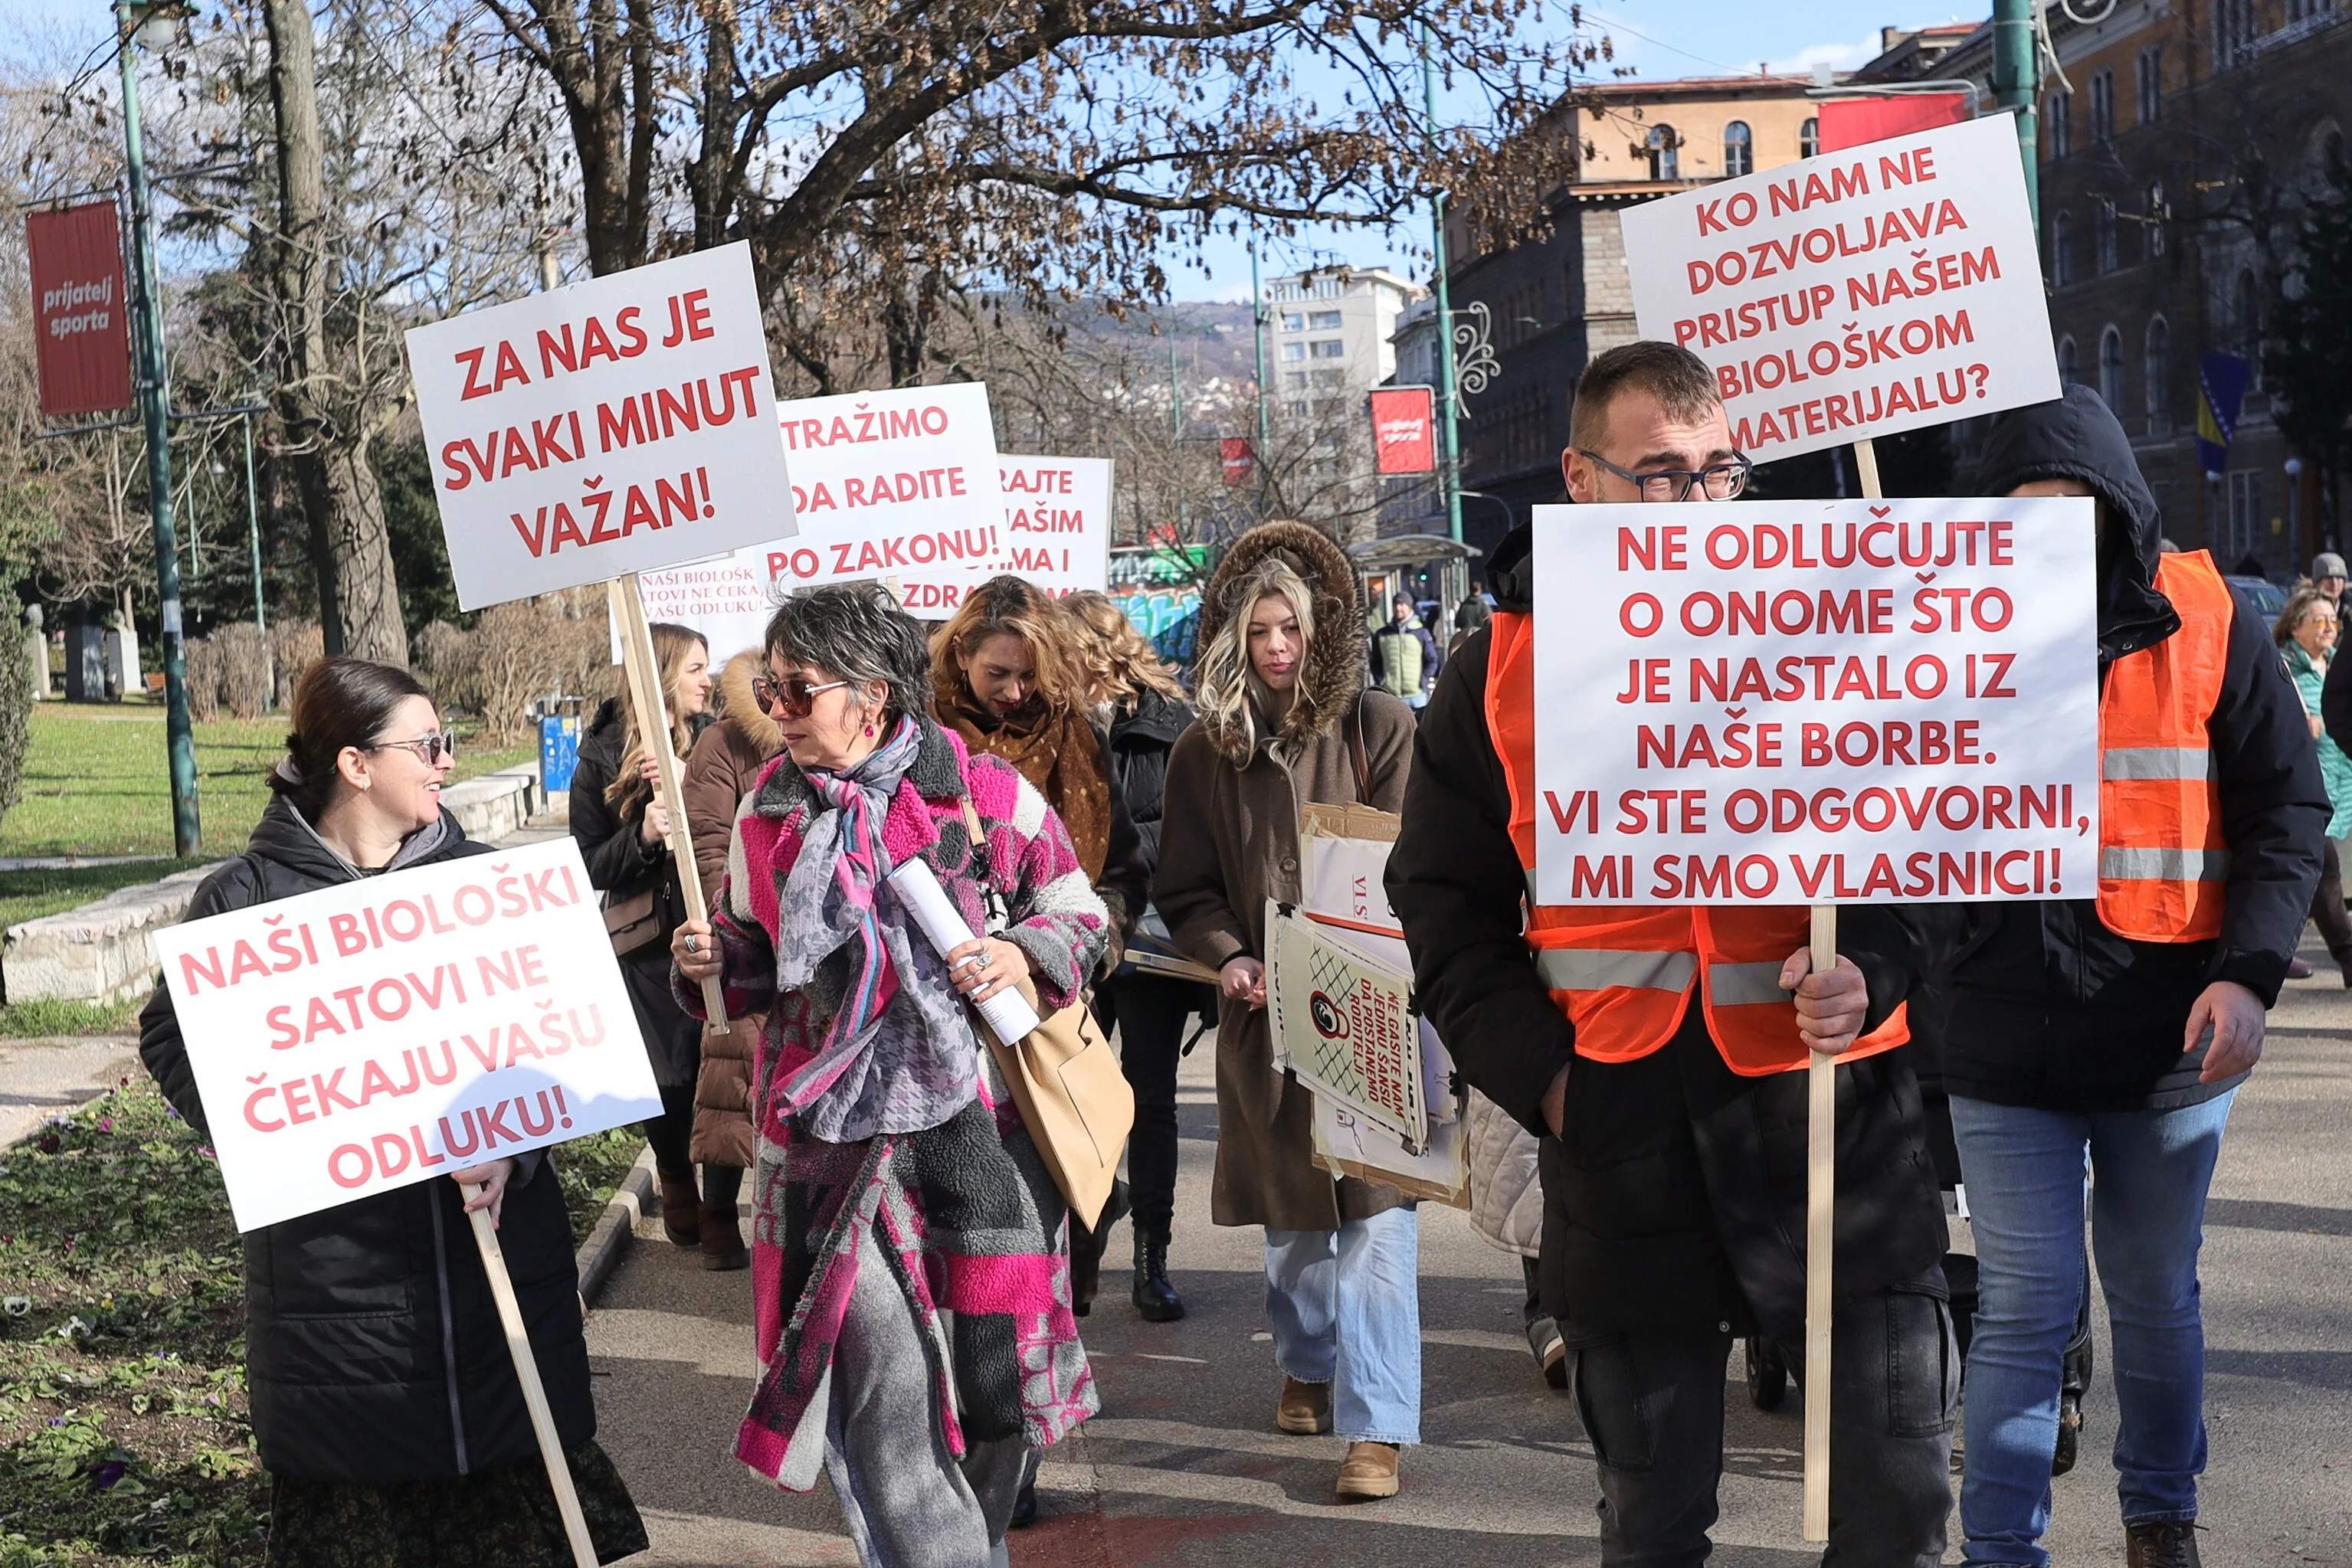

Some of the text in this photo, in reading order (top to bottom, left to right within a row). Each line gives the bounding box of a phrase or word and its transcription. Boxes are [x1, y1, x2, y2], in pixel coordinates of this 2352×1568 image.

[1695, 146, 1936, 237] KO NAM NE
[1686, 198, 1967, 296] DOZVOLJAVA
[43, 274, 113, 315] prijatelj
[51, 309, 109, 341] sporta
[1674, 246, 2001, 349] PRISTUP NAŠEM
[454, 288, 715, 401] ZA NAS JE
[1717, 309, 1974, 400] BIOLOŠKOM
[441, 365, 760, 491] SVAKI MINUT
[780, 402, 948, 450] TRAŽIMO
[1728, 363, 1990, 451] MATERIJALU?
[509, 466, 716, 558] VAŽAN!
[845, 466, 967, 507] RADITE
[1005, 500, 1083, 533] AŠIM
[767, 525, 999, 582] PO ZAKONU!
[1063, 548, 1069, 572] I
[1618, 506, 2014, 571] NE ODLUČUJTE
[641, 588, 686, 603] TOVI
[691, 585, 712, 599] NE
[642, 571, 679, 587] NAŠI
[690, 601, 763, 615] ODLUKU!
[1619, 572, 2013, 638] O ONOME ŠTO
[1617, 653, 2016, 704] JE NASTALO IZ
[1637, 707, 1997, 769] NAŠE BORBE.
[1544, 784, 2090, 837] VI STE ODGOVORNI,
[1354, 876, 1367, 898] VI
[1571, 848, 2062, 900] MI SMO VLASNICI!
[179, 863, 581, 996] NAŠI BIOLOŠKI
[265, 943, 549, 1051] SATOVI NE
[243, 998, 606, 1134] ČEKAJU VAŠU
[1350, 993, 1364, 1076] RODITELJI
[1361, 977, 1379, 1103] DA POSTANEMO
[1374, 987, 1392, 1110] JEDINU ŠANSU
[1387, 990, 1404, 1119] NE GASITE NAM
[327, 1085, 573, 1190] ODLUKU!
